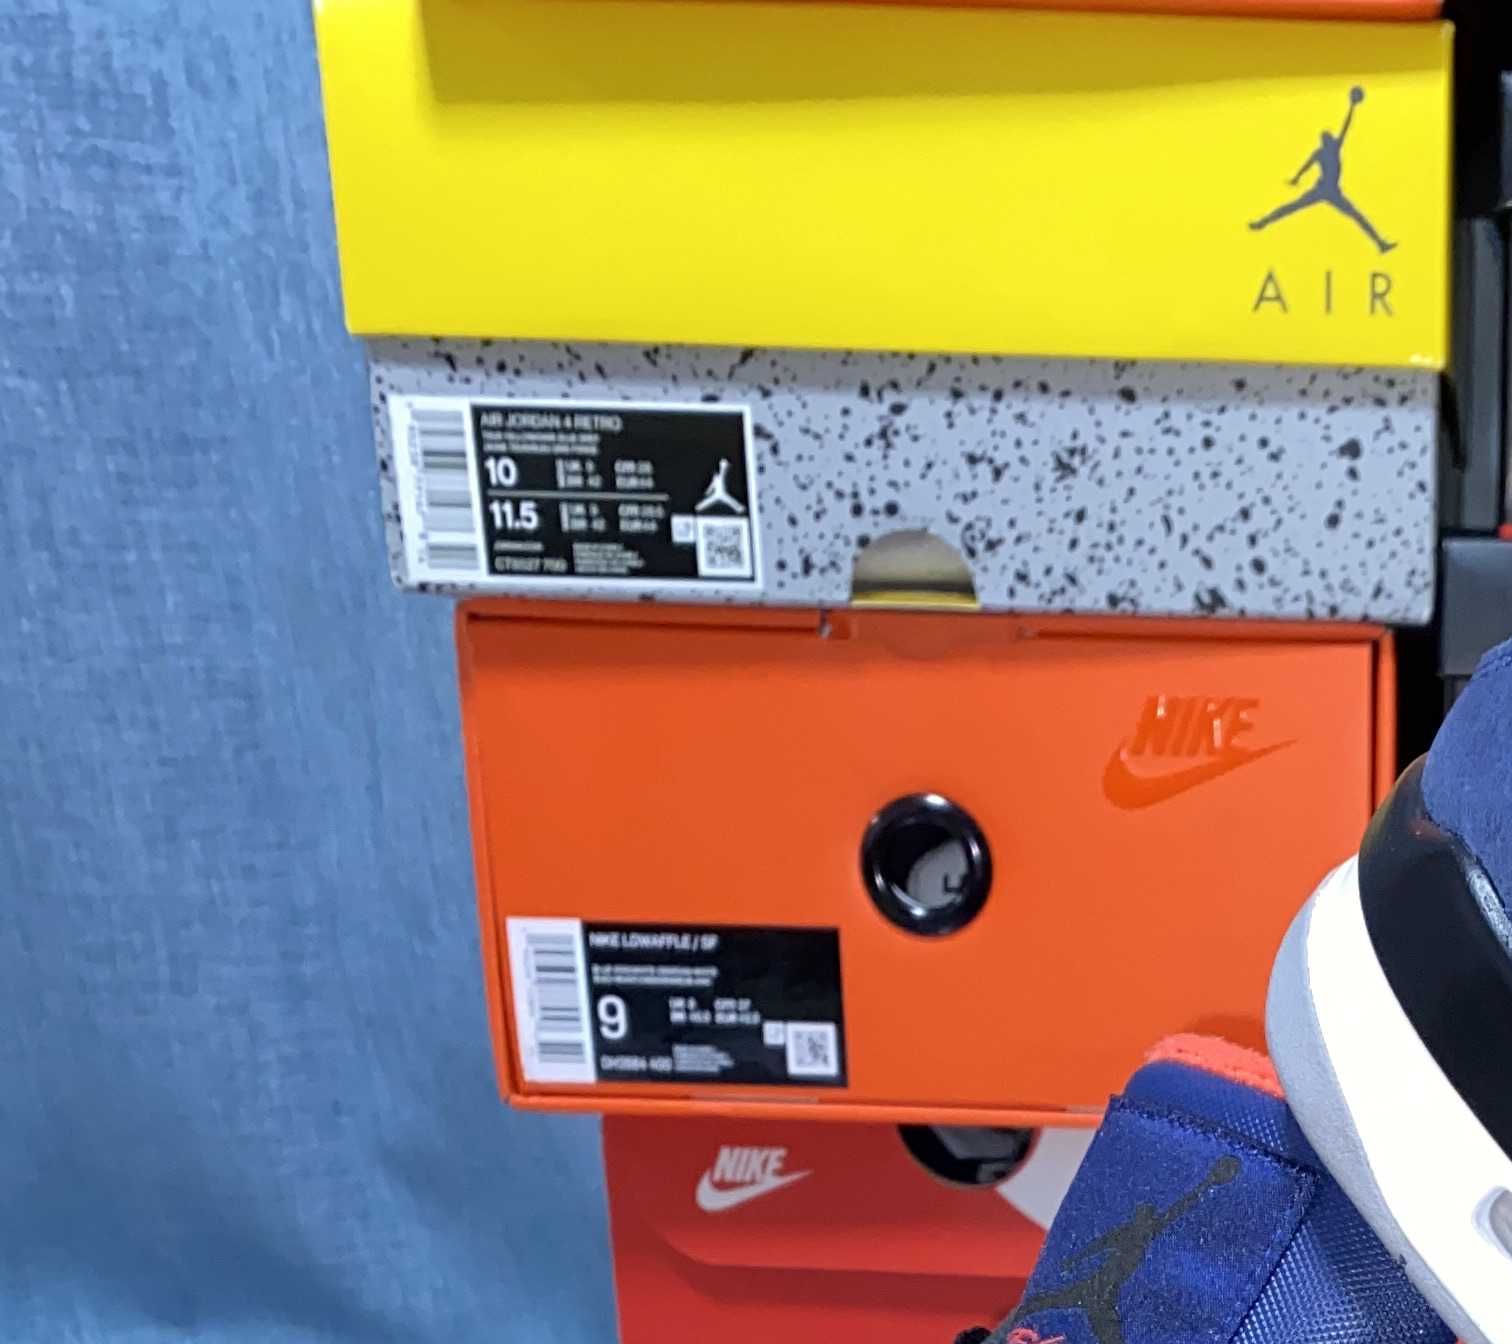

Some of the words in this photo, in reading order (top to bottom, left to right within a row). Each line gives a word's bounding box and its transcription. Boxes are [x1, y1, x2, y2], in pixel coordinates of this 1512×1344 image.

[1252, 270, 1395, 317] AIR
[506, 413, 561, 430] JORDAN
[484, 457, 518, 487] 10
[489, 500, 539, 531] 11.5
[1130, 695, 1260, 757] NIKE
[597, 995, 628, 1040] 9
[712, 1145, 789, 1183] NIKE
